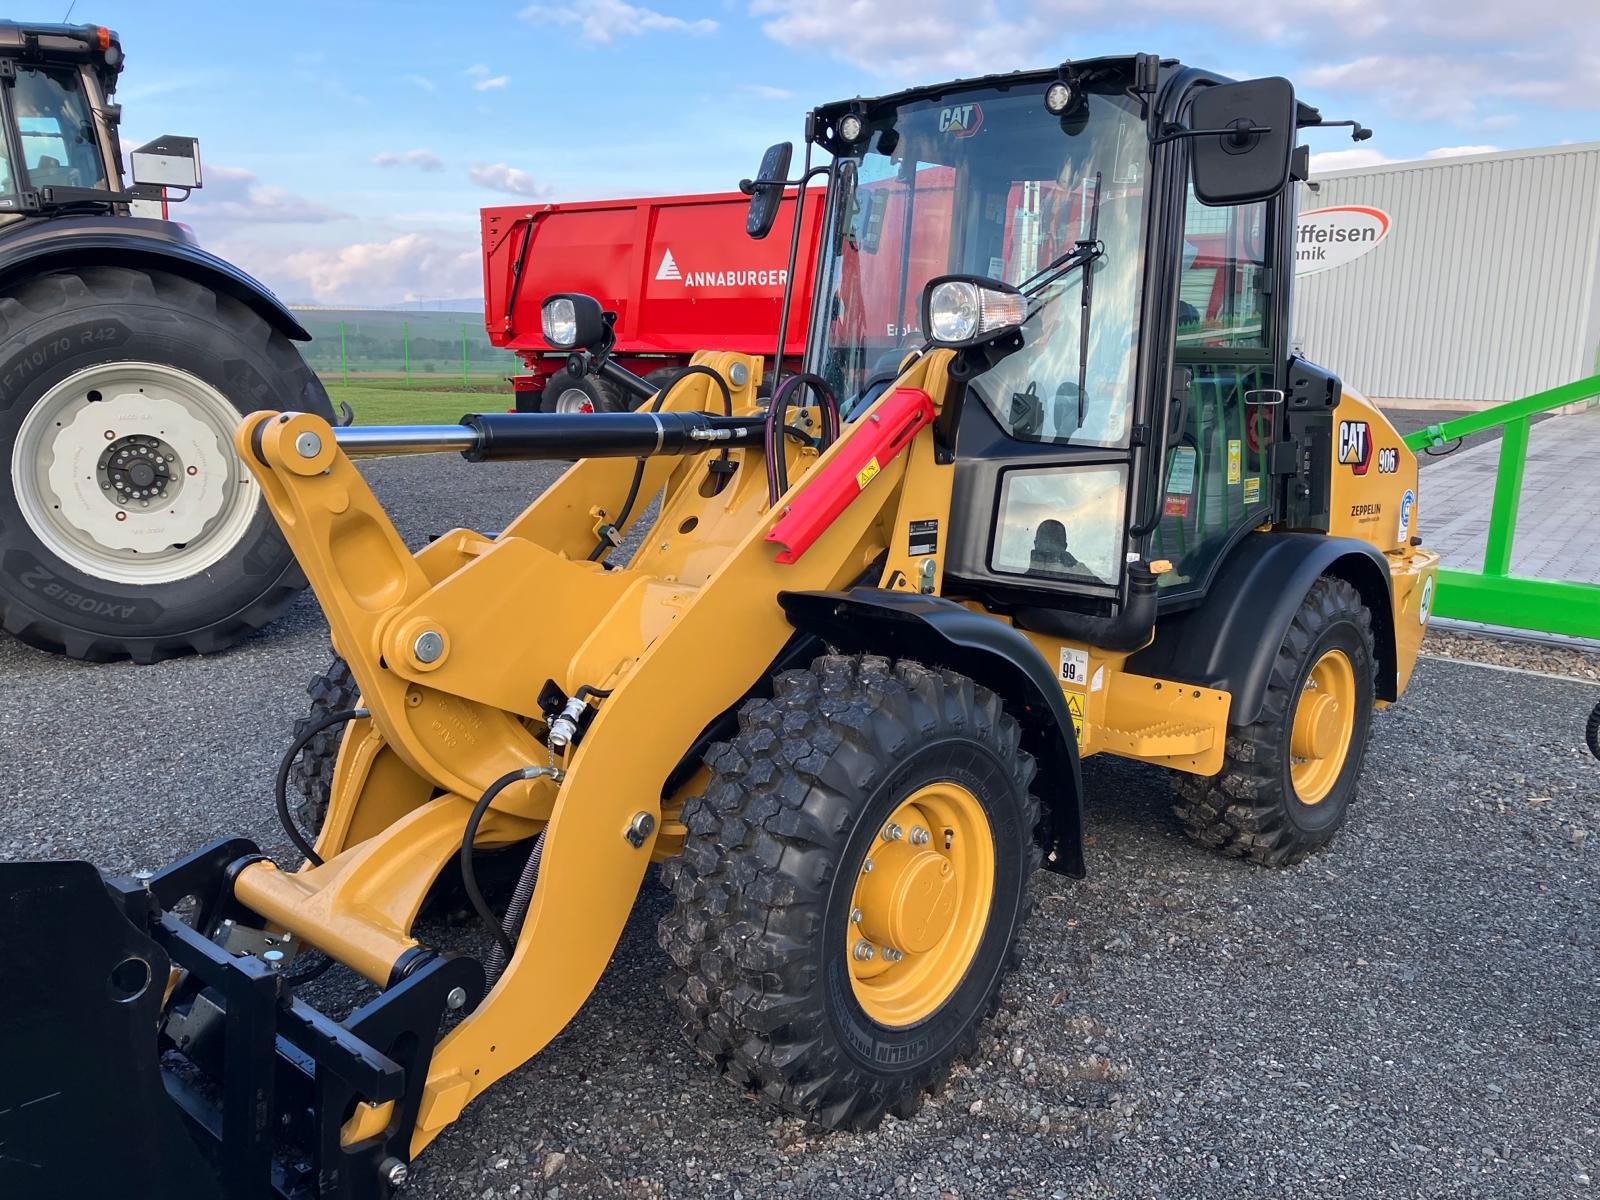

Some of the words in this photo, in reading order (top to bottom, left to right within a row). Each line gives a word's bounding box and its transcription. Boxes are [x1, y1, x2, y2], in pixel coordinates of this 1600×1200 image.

[939, 105, 973, 132] CAT
[684, 269, 788, 287] ANNABURGER
[14, 337, 71, 378] 710/70
[80, 327, 117, 344] R42
[1339, 421, 1366, 463] CAT
[1379, 449, 1396, 473] 906
[1351, 504, 1381, 516] ZEPPELIN
[20, 566, 55, 590] 2
[42, 583, 137, 618] AXIOBIB
[1062, 662, 1076, 680] 99
[875, 1037, 934, 1064] CHELIN
